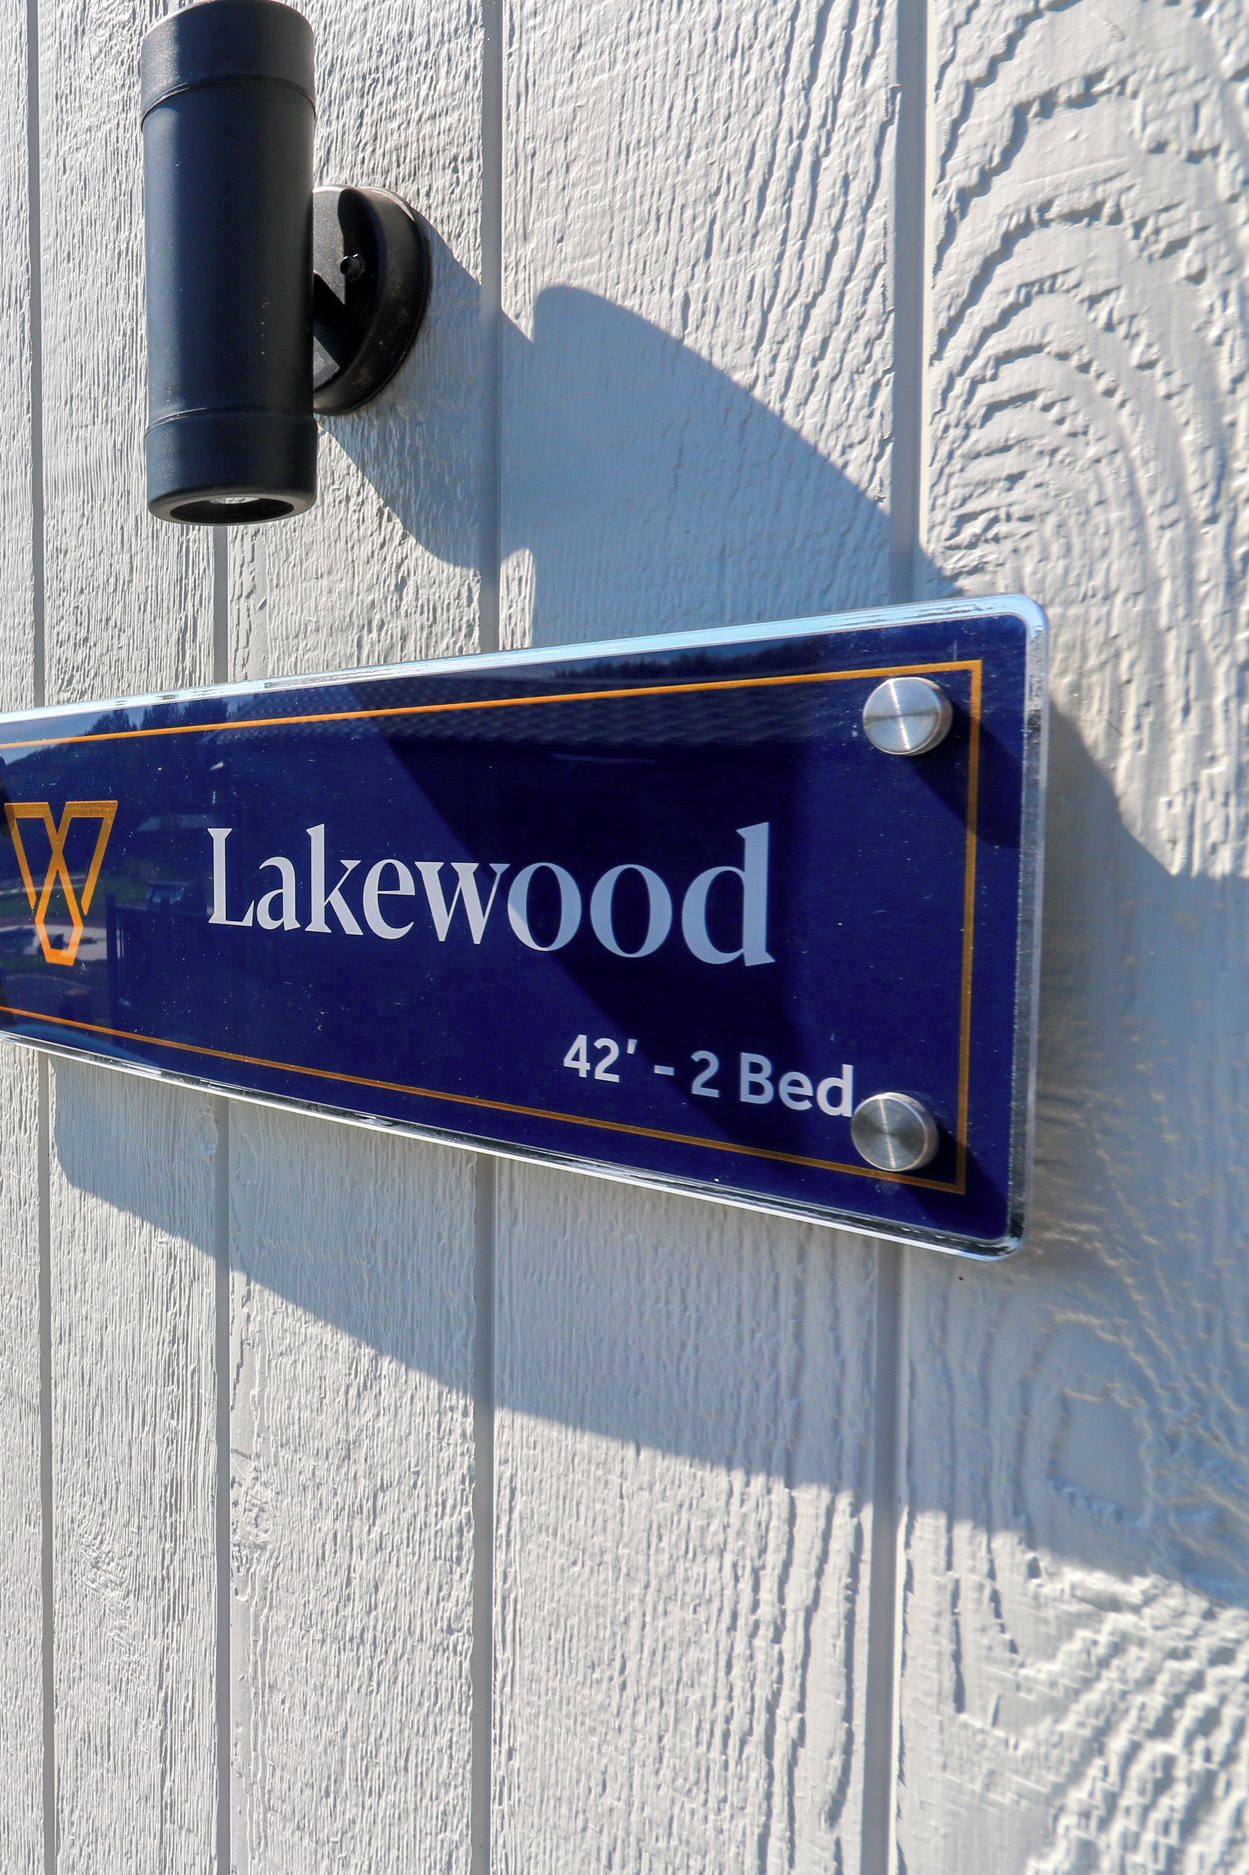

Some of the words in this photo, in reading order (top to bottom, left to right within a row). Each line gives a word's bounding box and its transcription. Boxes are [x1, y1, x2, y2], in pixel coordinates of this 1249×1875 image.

[207, 822, 776, 967] Lakewood
[690, 1050, 720, 1098] 2
[739, 1052, 854, 1118] Bed
